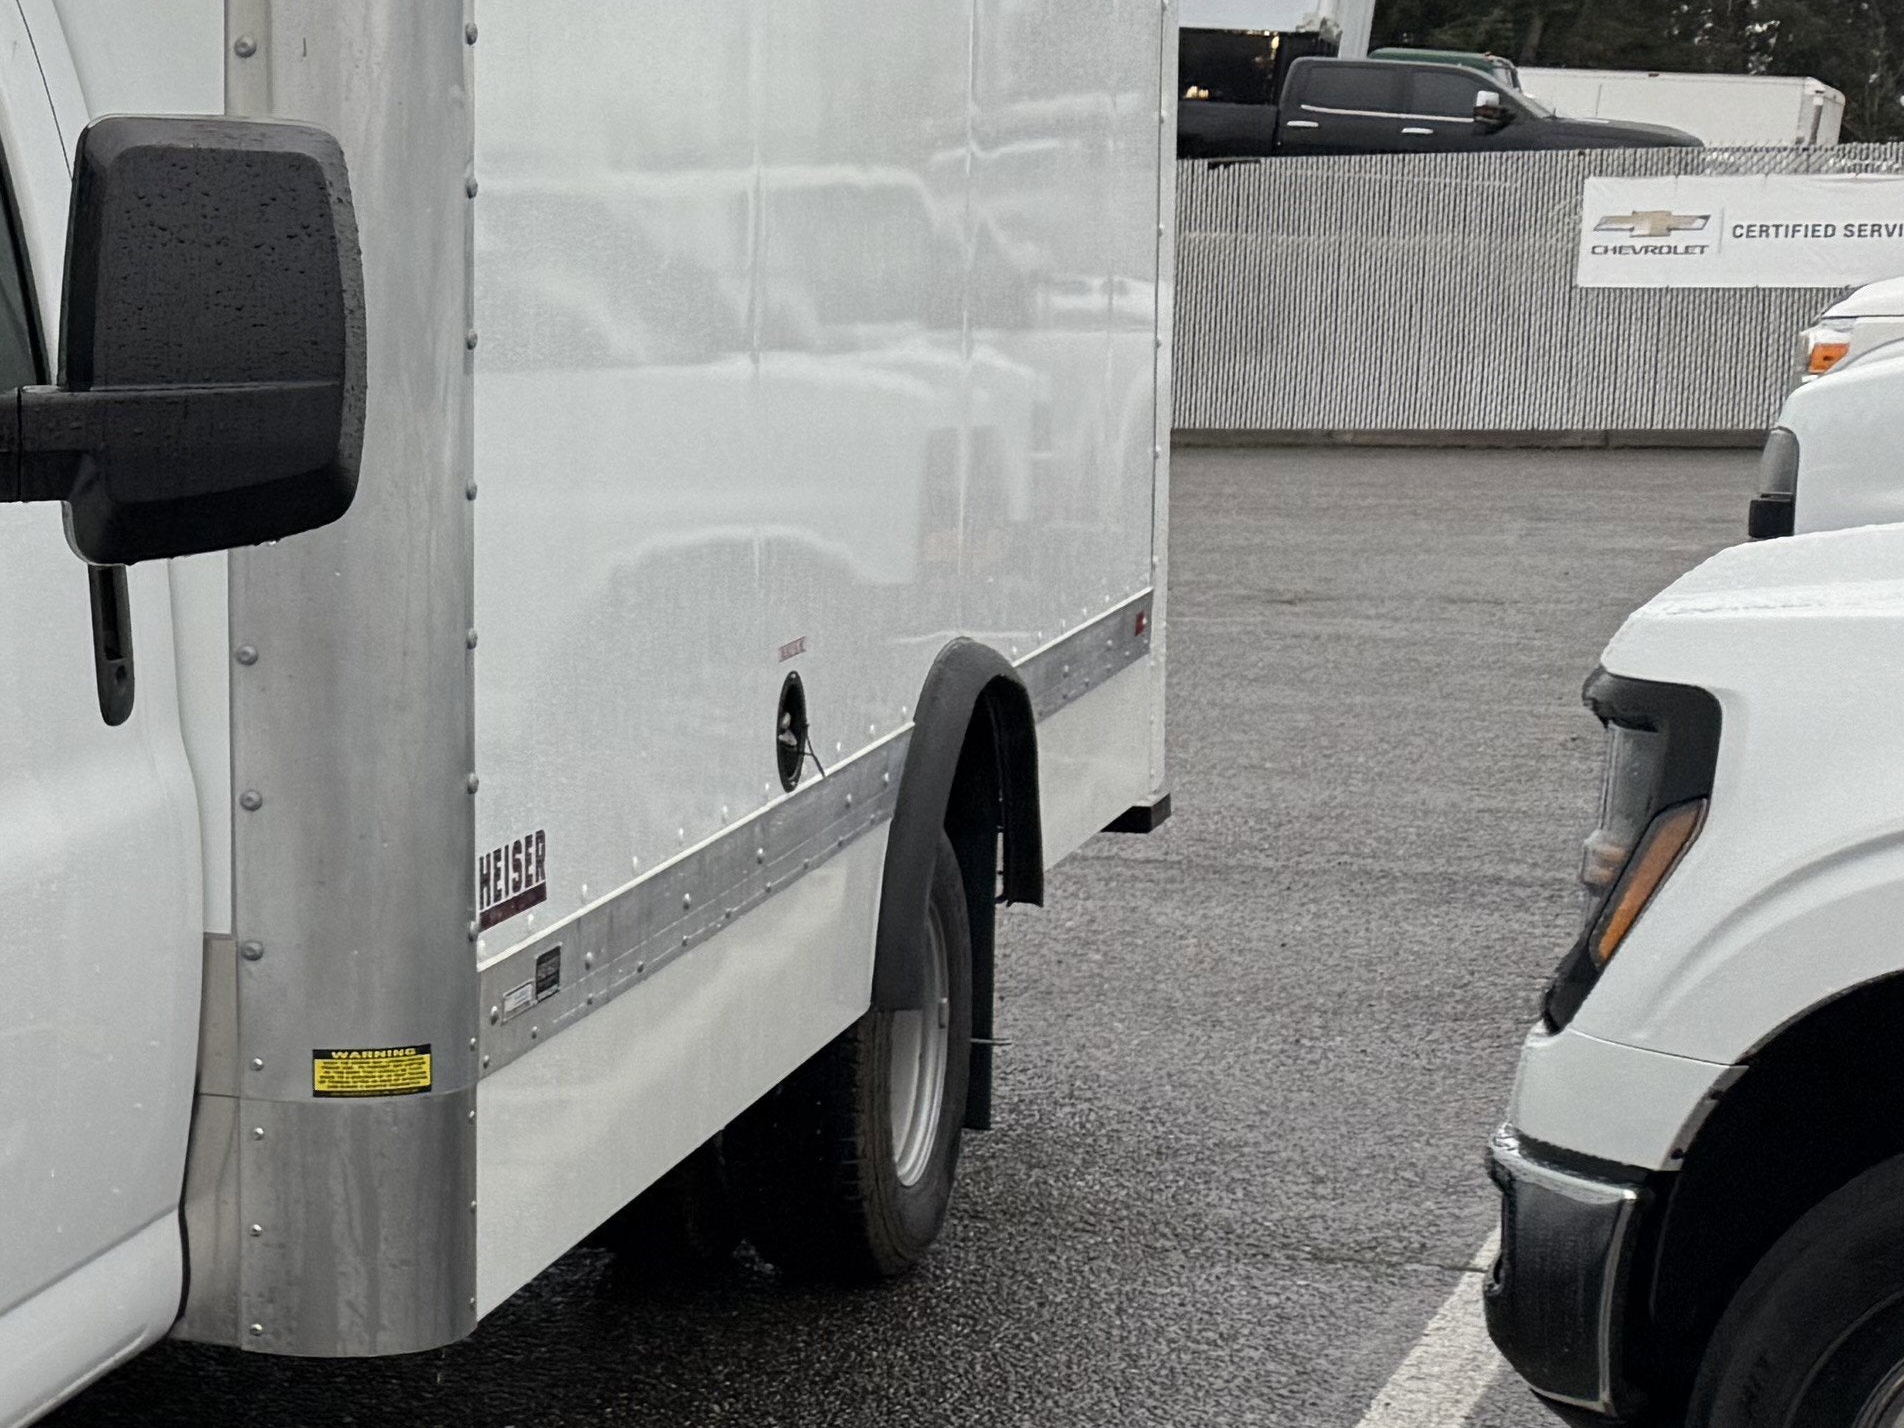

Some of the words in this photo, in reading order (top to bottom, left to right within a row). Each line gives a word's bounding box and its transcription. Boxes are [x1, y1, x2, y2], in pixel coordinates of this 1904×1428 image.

[1732, 223, 1836, 239] CERTIFIED
[1843, 223, 1904, 238] SERVI
[1591, 245, 1709, 255] CHEVROLET
[479, 829, 546, 910] HEISER
[331, 1048, 417, 1059] WARNING
